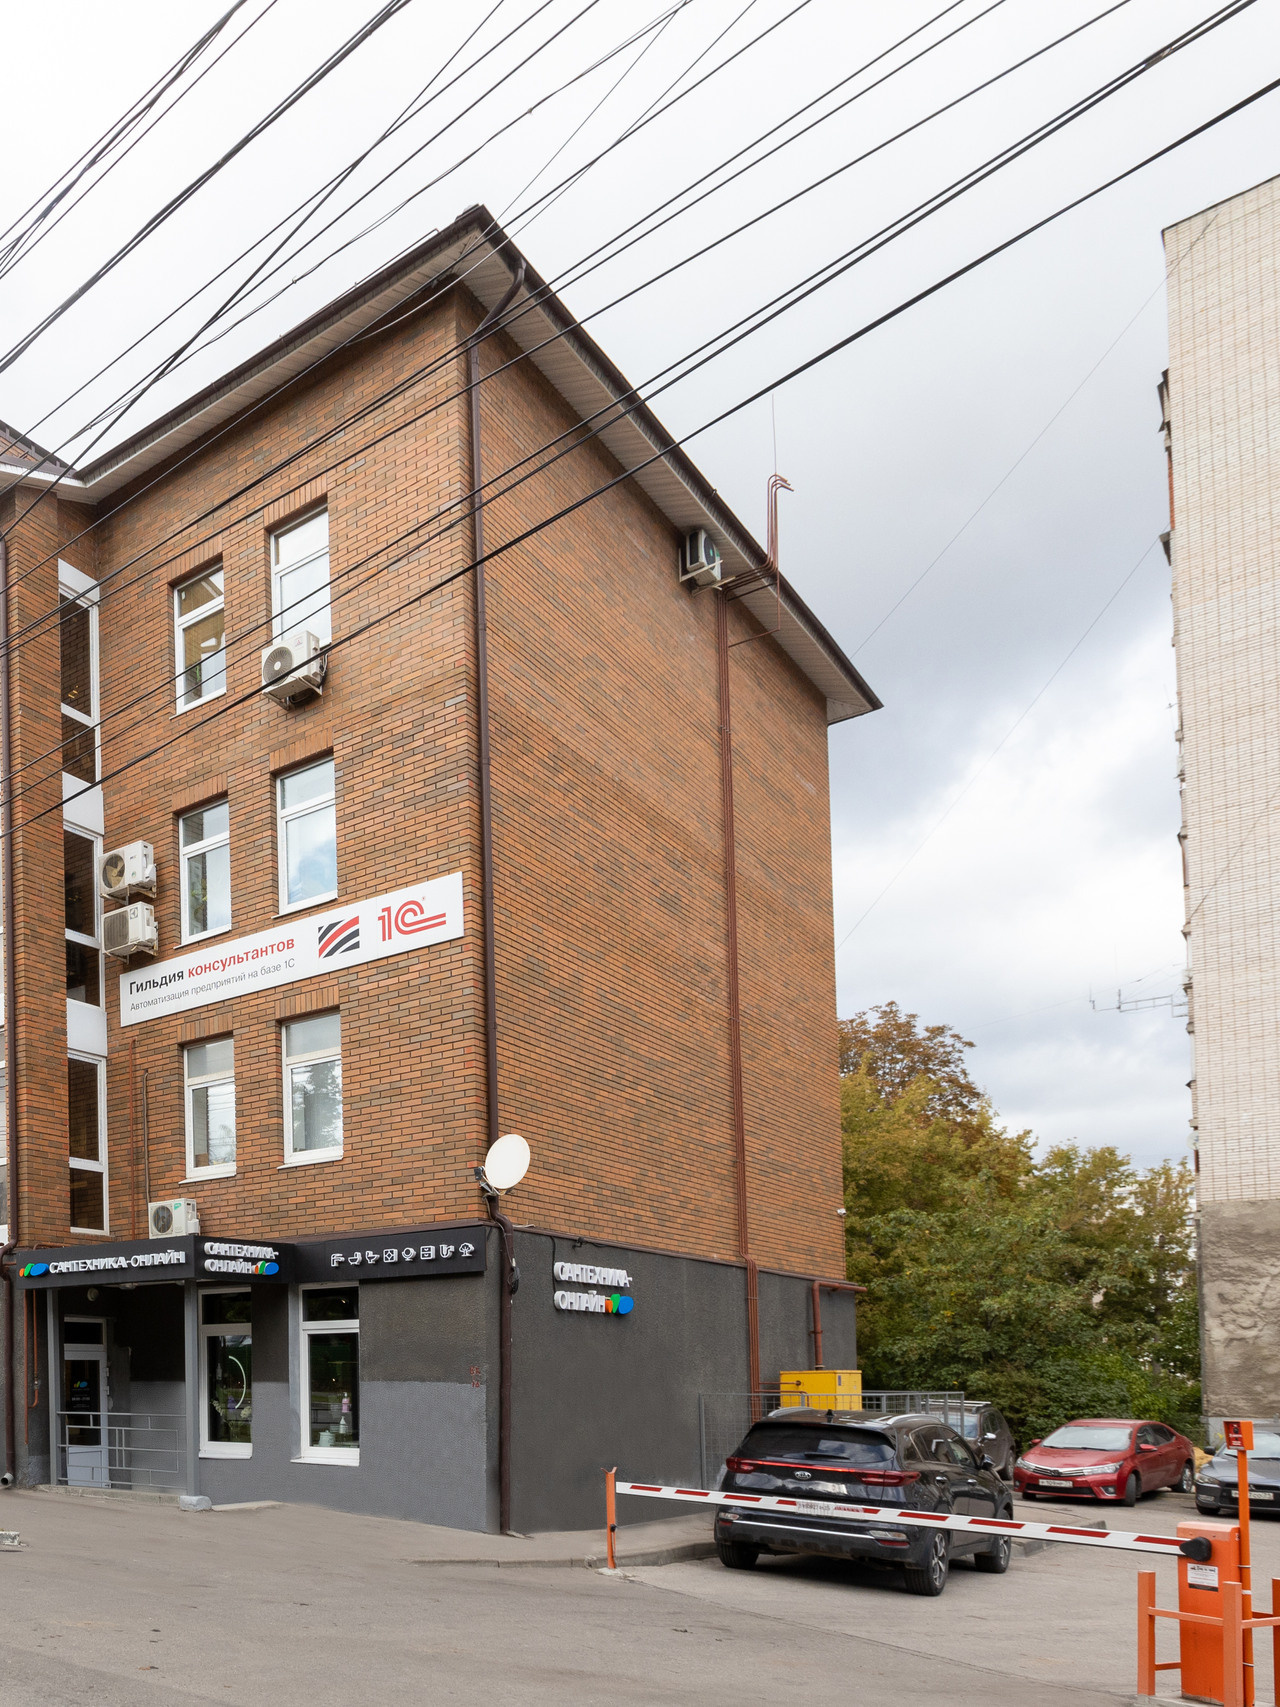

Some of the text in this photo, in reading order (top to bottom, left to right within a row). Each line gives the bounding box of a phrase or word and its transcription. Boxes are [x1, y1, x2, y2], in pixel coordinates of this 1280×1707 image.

[129, 938, 295, 995] Гильдия консультантов
[130, 958, 296, 1011] Автоматизация предприятий на базе 1С
[49, 1250, 186, 1274] САНТЕХНИКА-ОНЛАЙН
[204, 1242, 279, 1259] САНТЕХНИКА-
[204, 1258, 252, 1274] ОНЛАЙН
[554, 1262, 632, 1287] САНТЕХНИКА-
[554, 1290, 606, 1313] ОНЛАЙН
